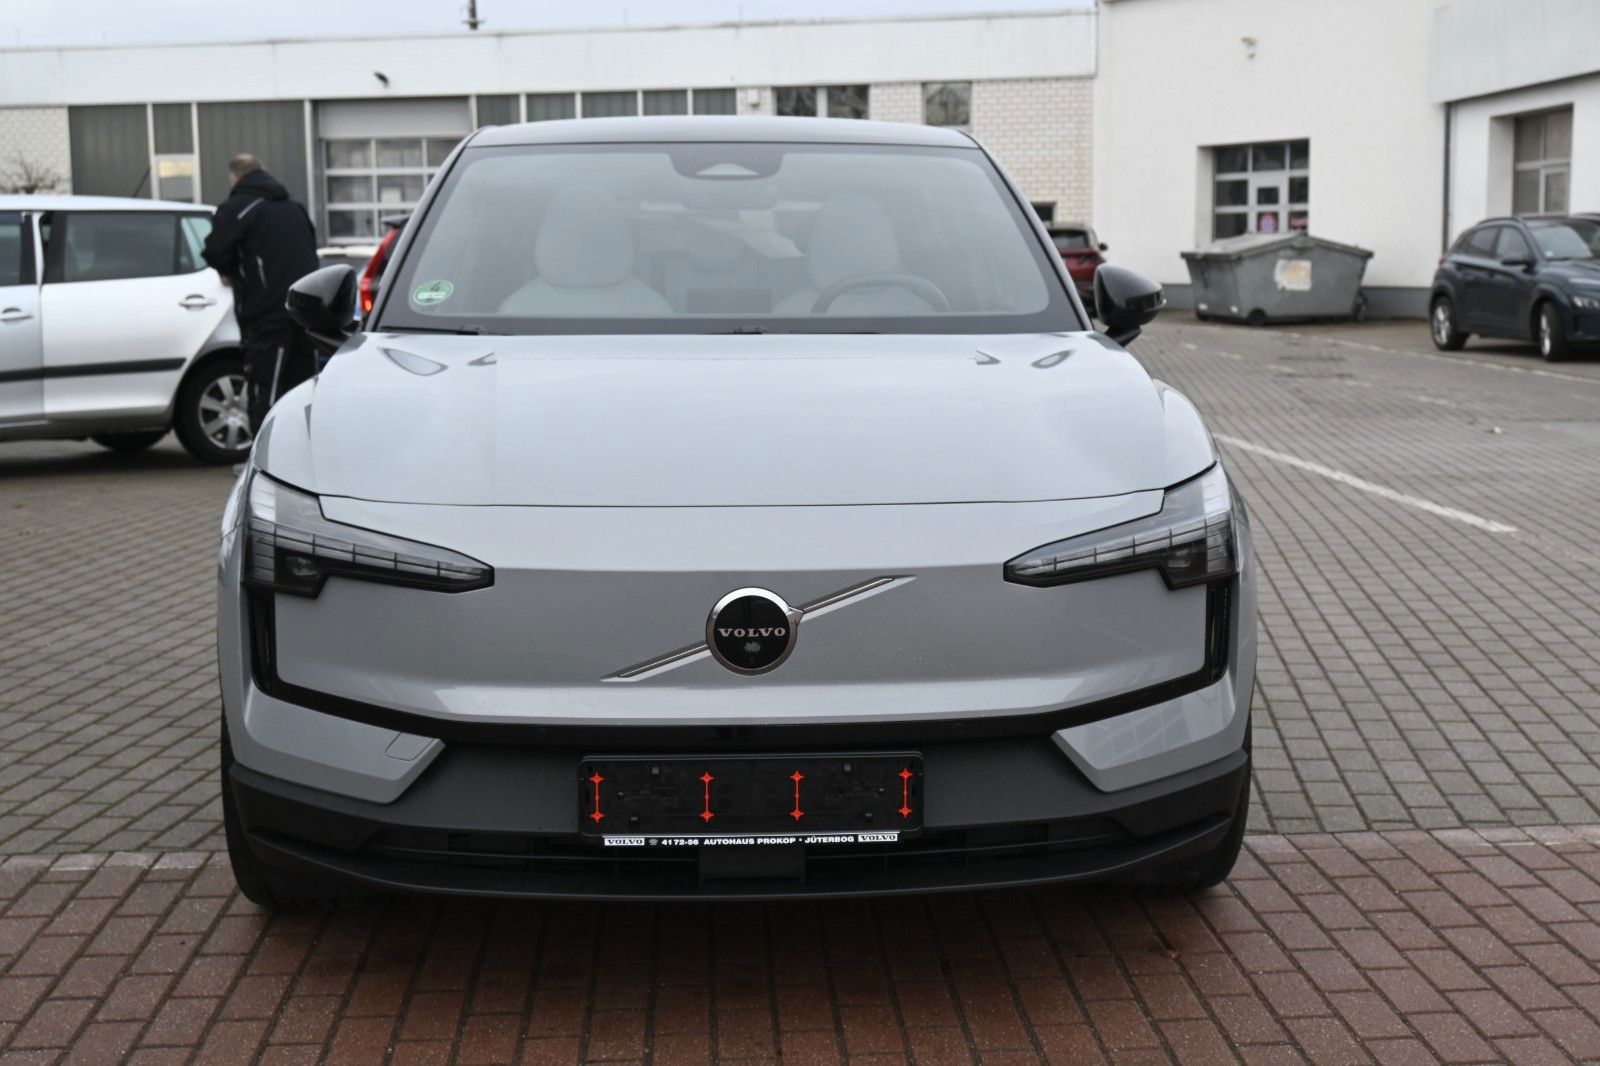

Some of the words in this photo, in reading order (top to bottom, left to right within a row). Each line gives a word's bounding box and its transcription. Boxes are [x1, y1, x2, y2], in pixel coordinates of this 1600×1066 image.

[718, 627, 786, 638] VOLVO
[703, 838, 755, 846] AUTOHAUS
[757, 837, 796, 845] PROKOP
[804, 835, 854, 844] JÜTERBOG
